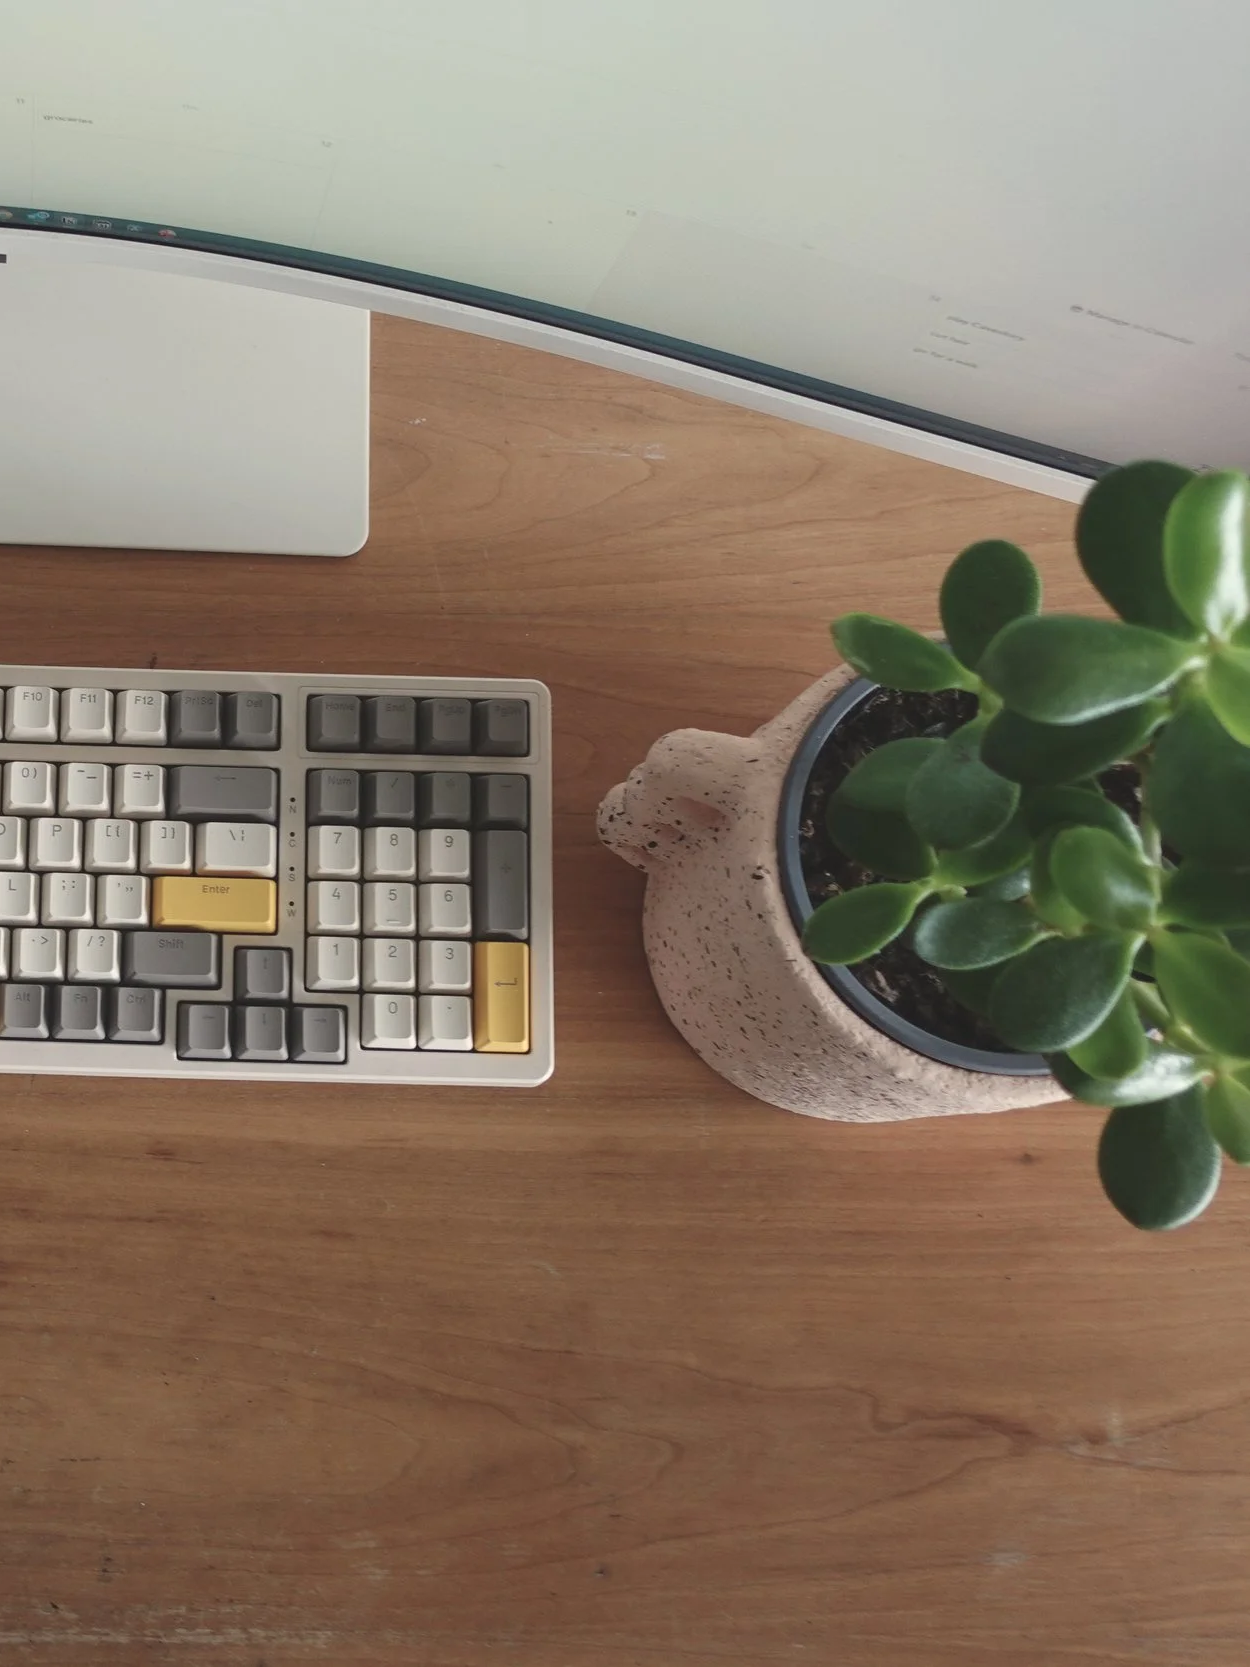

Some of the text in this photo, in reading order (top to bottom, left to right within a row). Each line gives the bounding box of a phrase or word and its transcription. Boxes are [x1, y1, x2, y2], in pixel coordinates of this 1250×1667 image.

[23, 692, 42, 701] F10
[80, 694, 96, 703] F11
[135, 696, 153, 705] F12
[52, 825, 62, 836] P
[334, 832, 342, 844] 7
[390, 833, 398, 846] 8
[444, 836, 453, 847] 9
[8, 879, 17, 891] L
[202, 885, 230, 894] Enter
[332, 888, 340, 900] 4
[389, 889, 397, 901] 5
[444, 890, 453, 902] 6
[158, 938, 184, 948] Shift
[388, 945, 397, 957] 2
[446, 948, 454, 960] 3
[388, 1002, 398, 1014] 0
